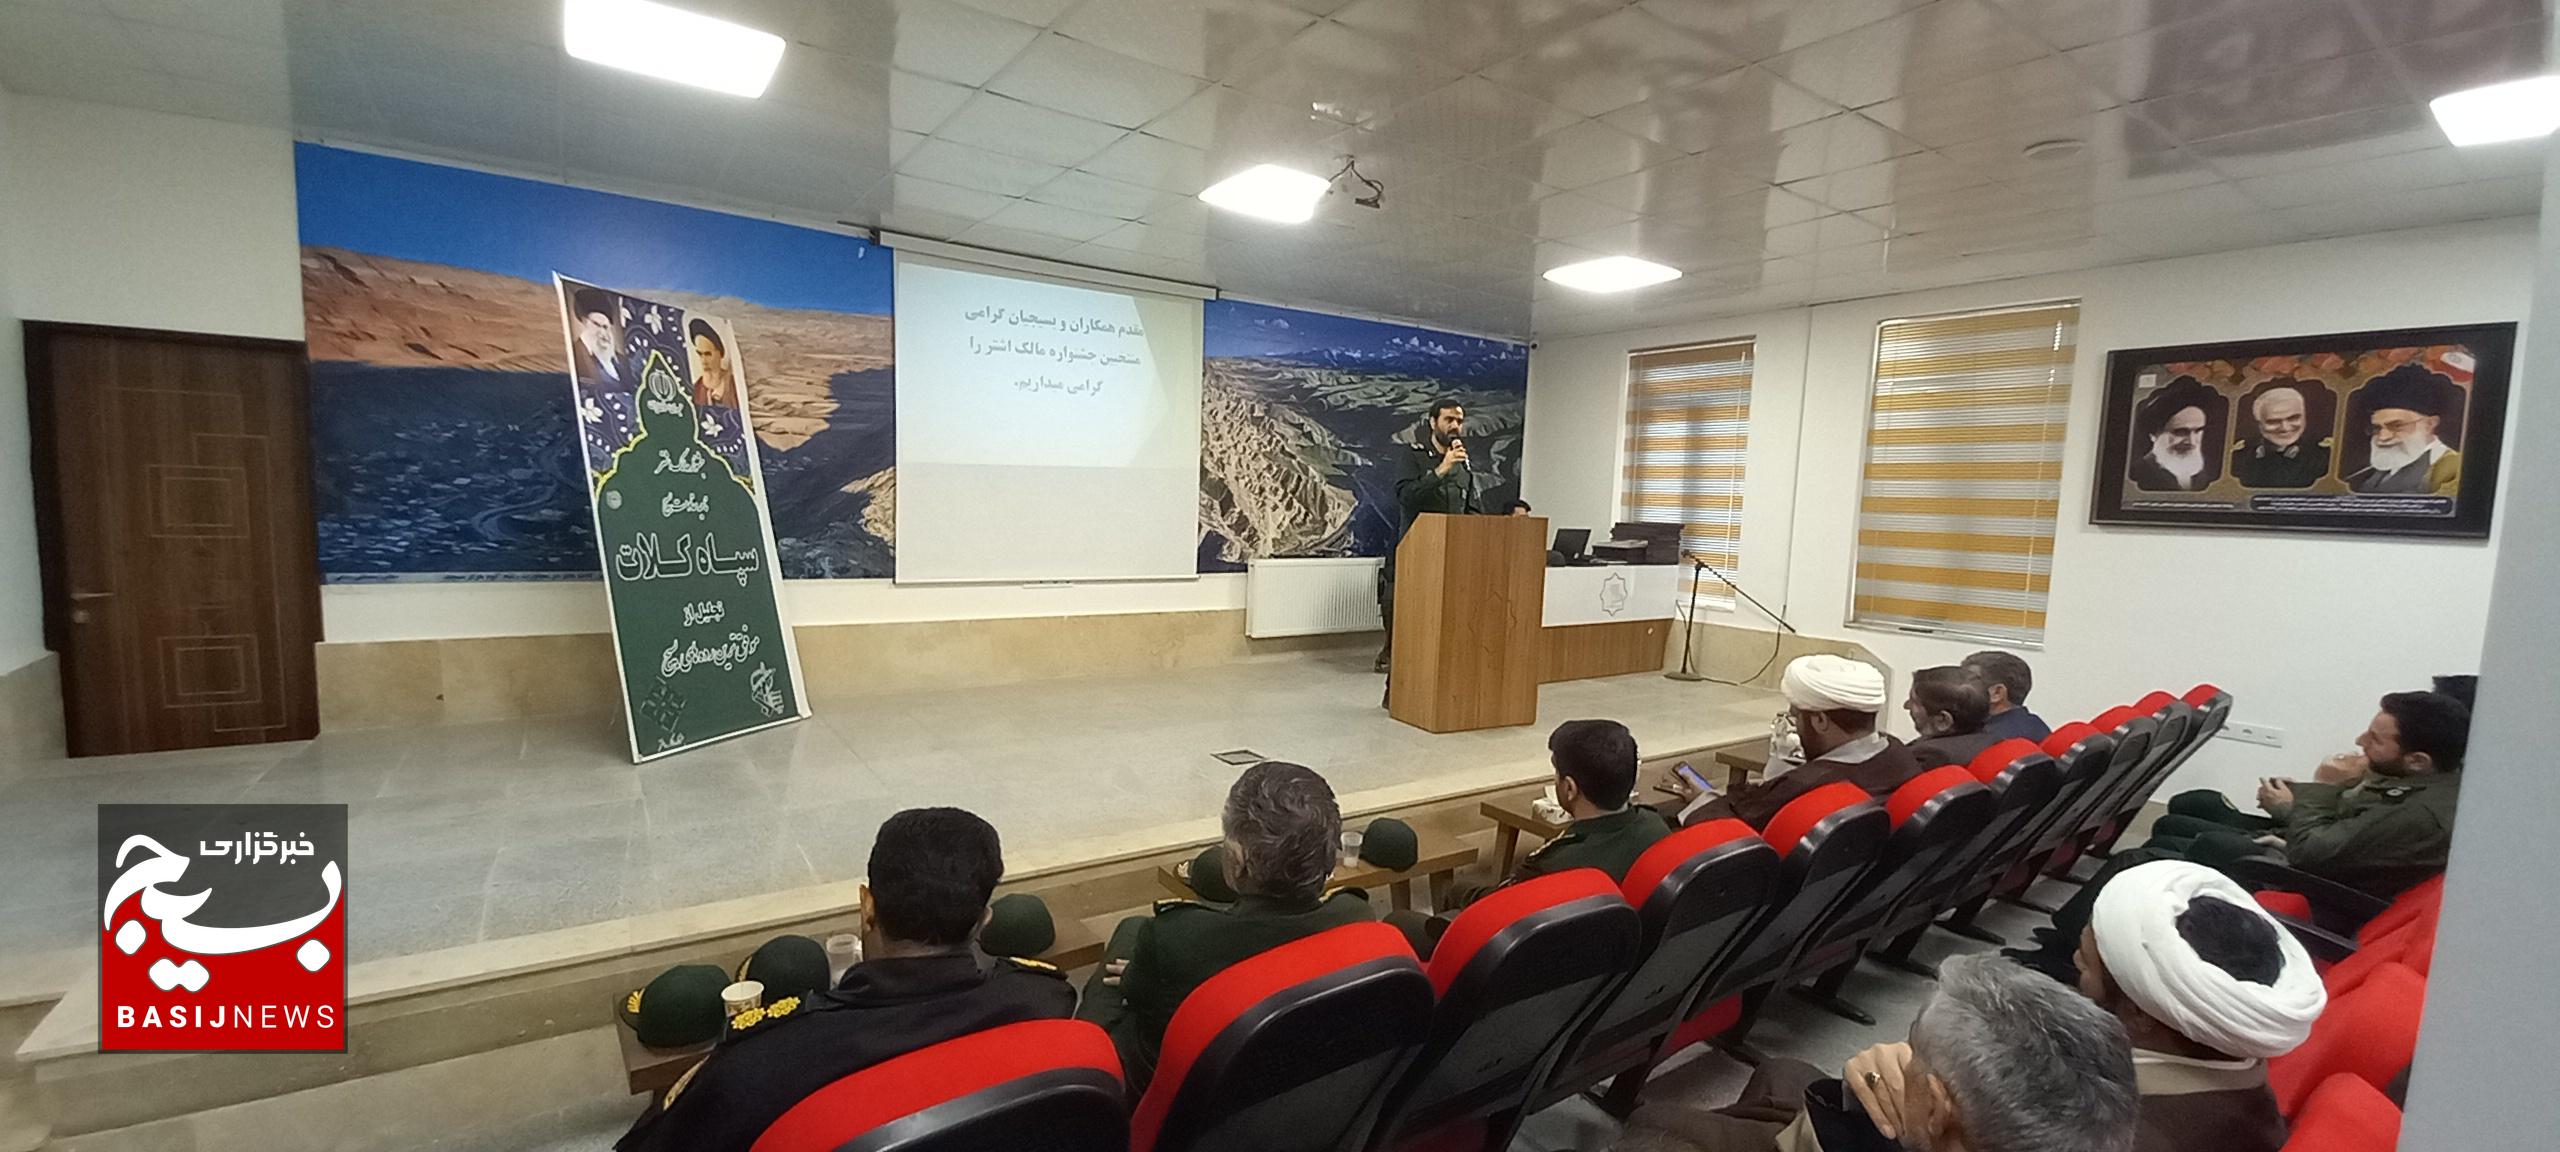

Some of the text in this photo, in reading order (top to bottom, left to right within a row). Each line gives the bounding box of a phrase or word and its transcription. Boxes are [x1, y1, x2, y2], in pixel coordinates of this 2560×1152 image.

[964, 305, 1006, 324] گرامی
[1008, 309, 1057, 330] بسیجیان
[1059, 320, 1067, 332] و
[1069, 317, 1116, 335] همکاران
[969, 336, 982, 354] را
[985, 338, 1012, 355] اشتر
[1014, 341, 1046, 356] مالک
[1067, 378, 1104, 397] گرامی
[615, 532, 760, 588] سپاه کلات
